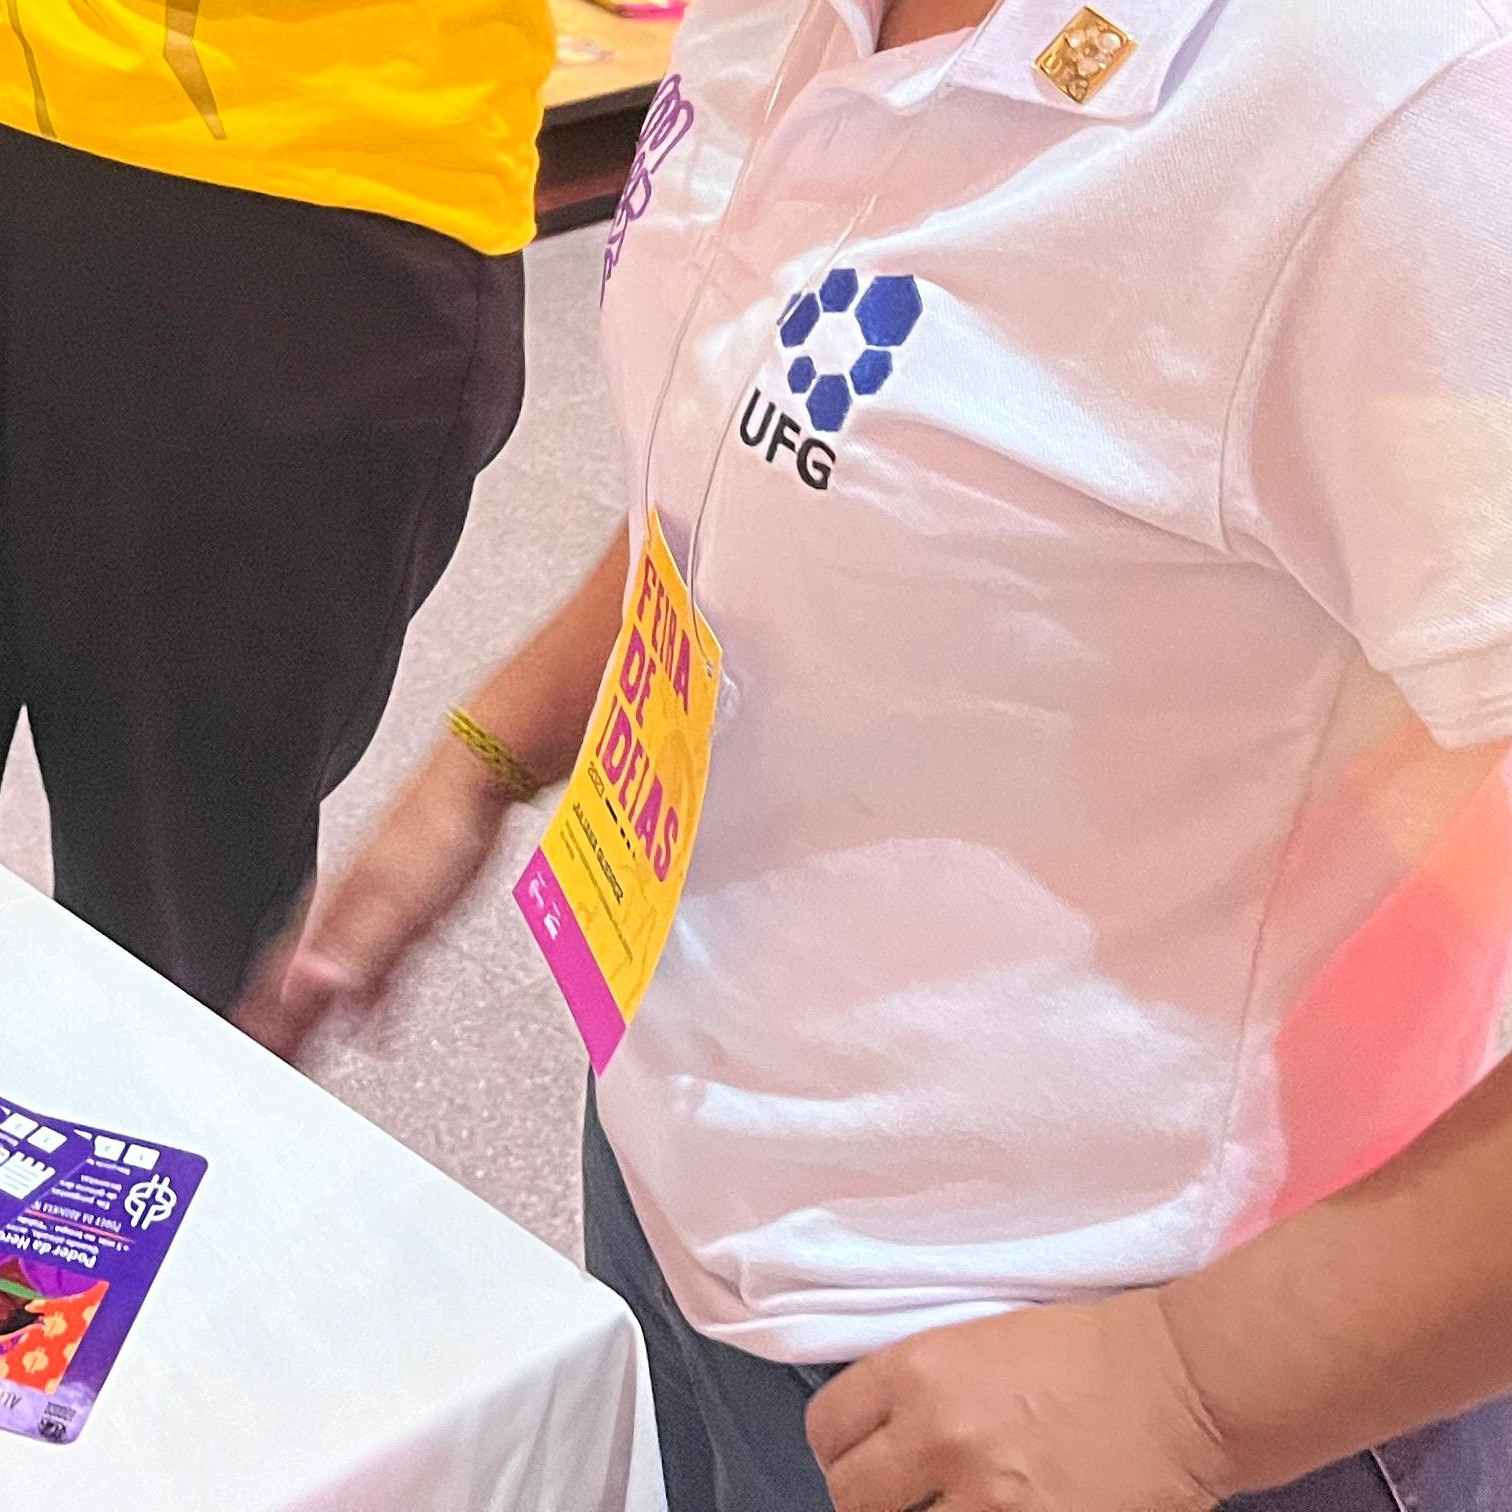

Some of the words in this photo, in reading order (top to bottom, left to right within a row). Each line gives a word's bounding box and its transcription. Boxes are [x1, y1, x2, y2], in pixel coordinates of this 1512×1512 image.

[739, 388, 837, 491] UFG
[619, 623, 658, 729] DE
[636, 554, 690, 716] FEIRA
[595, 693, 681, 883] IDEIAS
[30, 1238, 53, 1254] da
[50, 1244, 97, 1268] Poder
